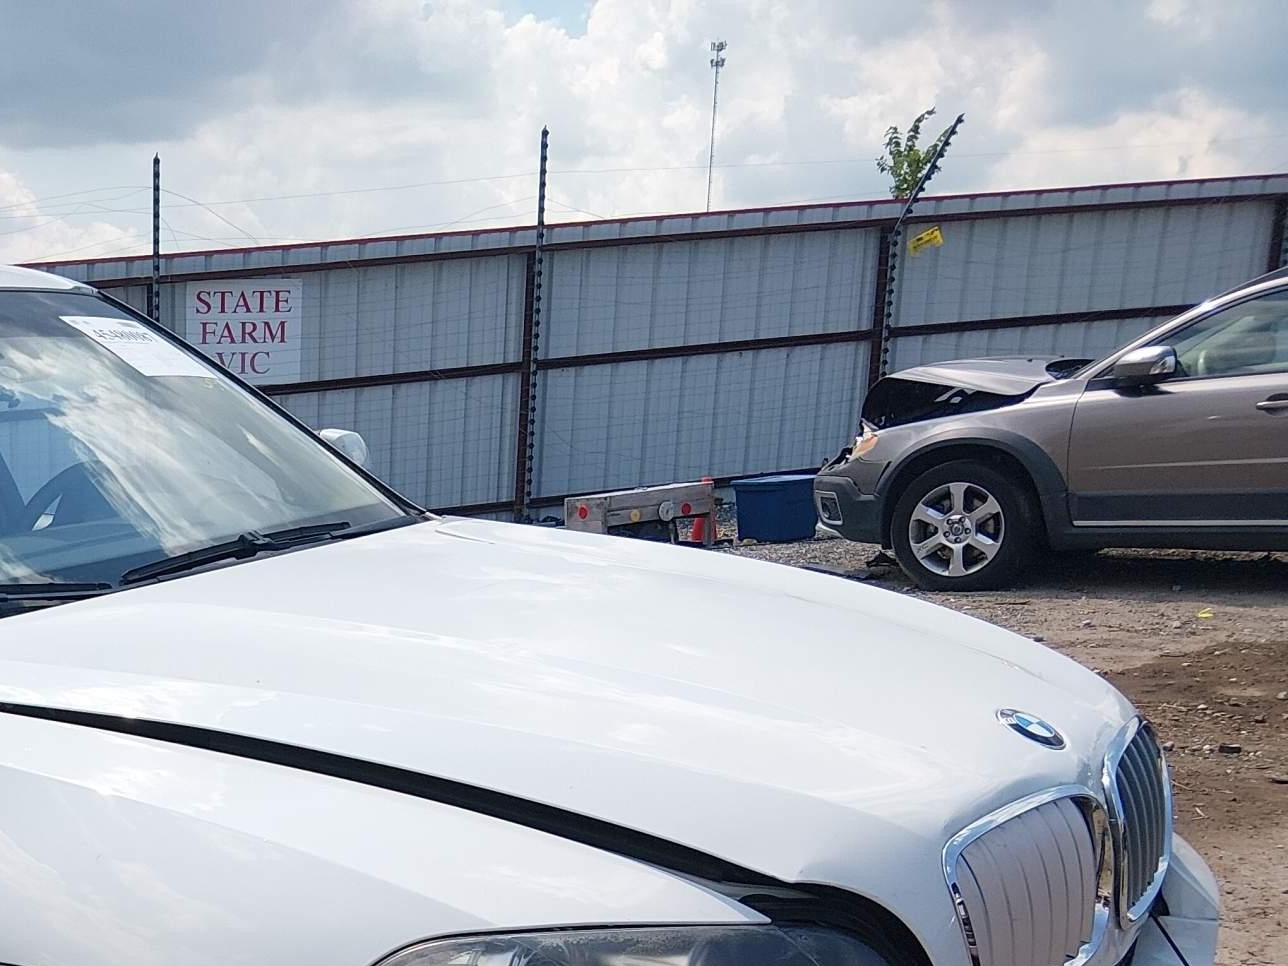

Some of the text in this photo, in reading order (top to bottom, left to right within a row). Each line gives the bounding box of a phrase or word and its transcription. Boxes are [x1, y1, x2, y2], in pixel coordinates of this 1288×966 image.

[195, 290, 292, 314] STATE
[200, 320, 288, 344] FARM
[216, 351, 270, 375] VIC
